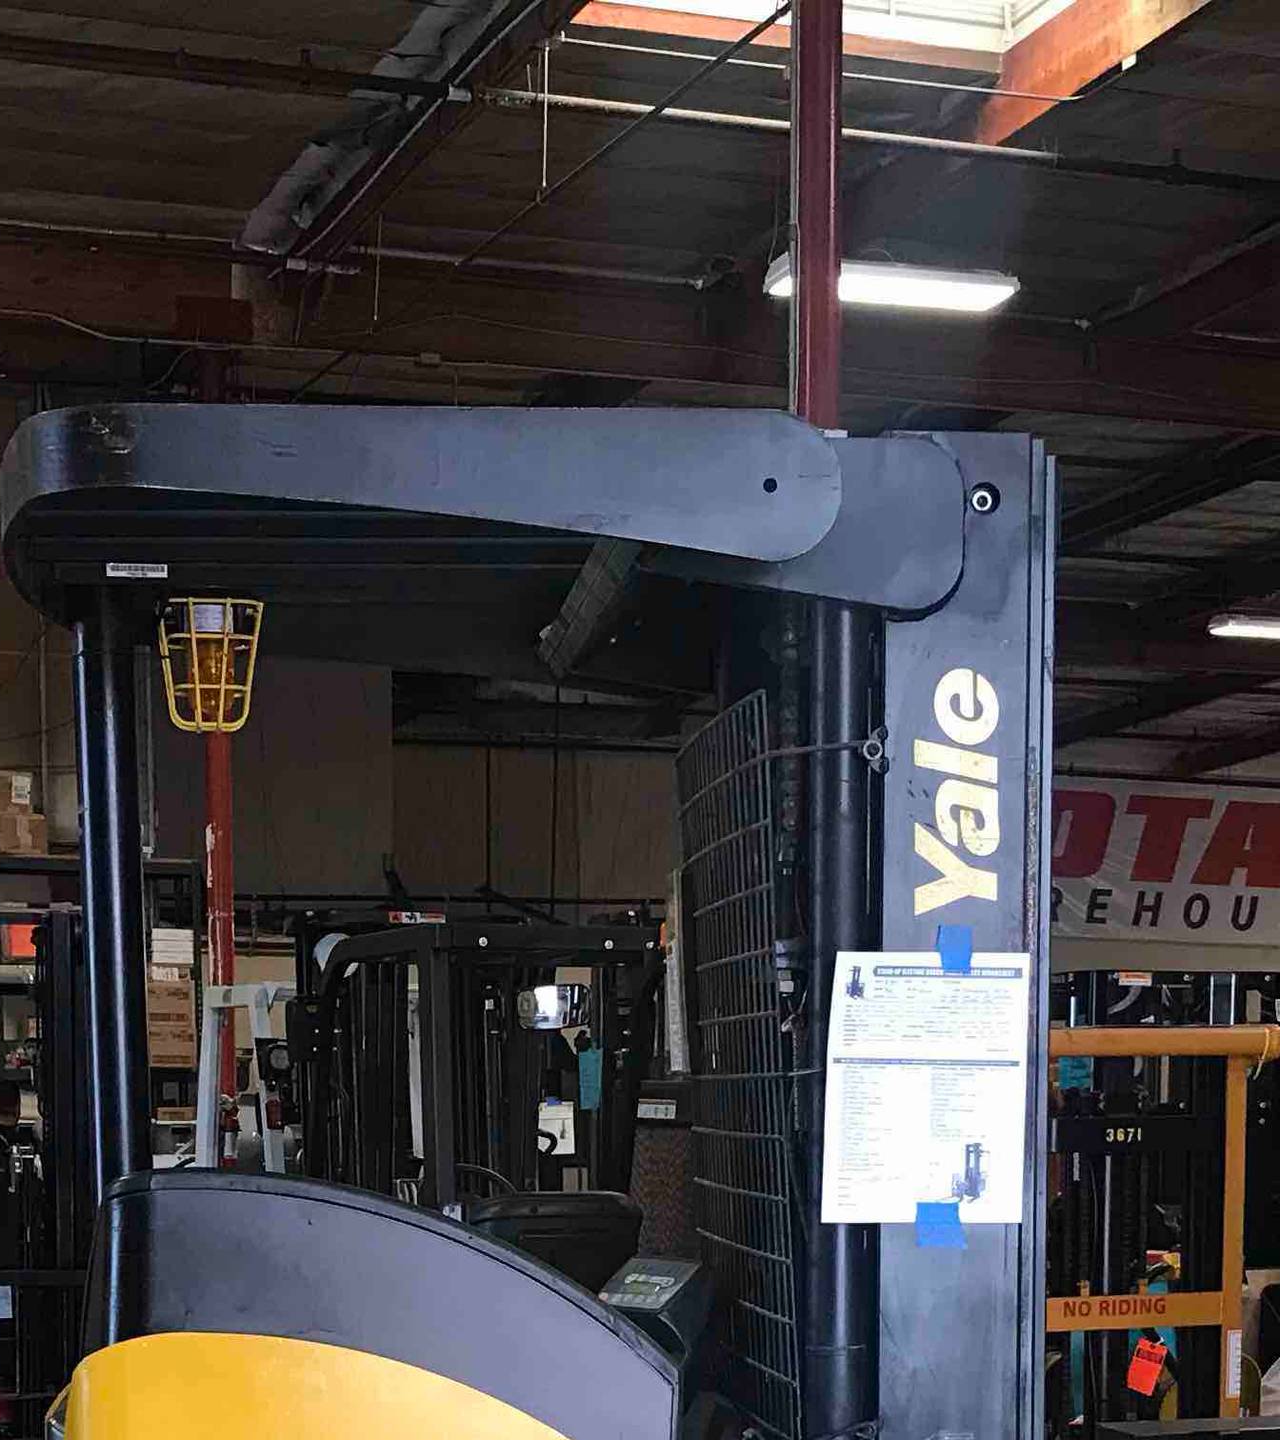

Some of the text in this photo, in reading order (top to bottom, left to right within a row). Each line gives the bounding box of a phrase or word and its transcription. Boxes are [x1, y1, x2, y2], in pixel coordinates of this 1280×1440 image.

[914, 668, 1000, 916] Yale
[1105, 1127, 1142, 1143] 3671
[1063, 1298, 1166, 1318] NO RIDING
